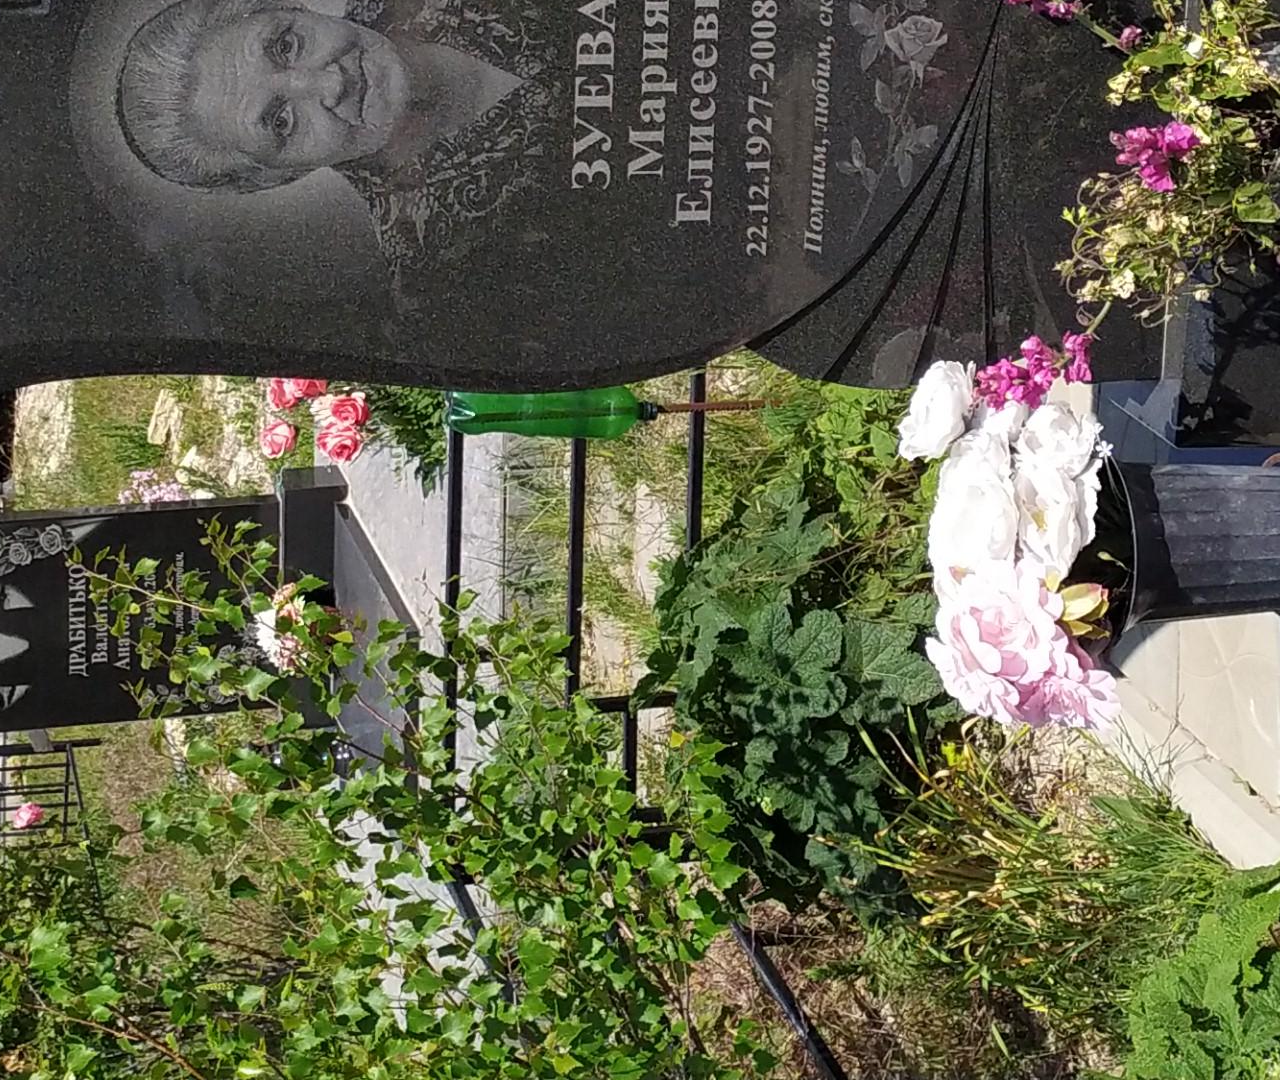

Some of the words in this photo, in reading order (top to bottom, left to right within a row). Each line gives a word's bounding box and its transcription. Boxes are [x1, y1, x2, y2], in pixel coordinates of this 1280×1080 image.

[809, 36, 836, 132] любим,
[803, 137, 833, 254] Помним,
[68, 565, 89, 677] ДРАБИТЬКО
